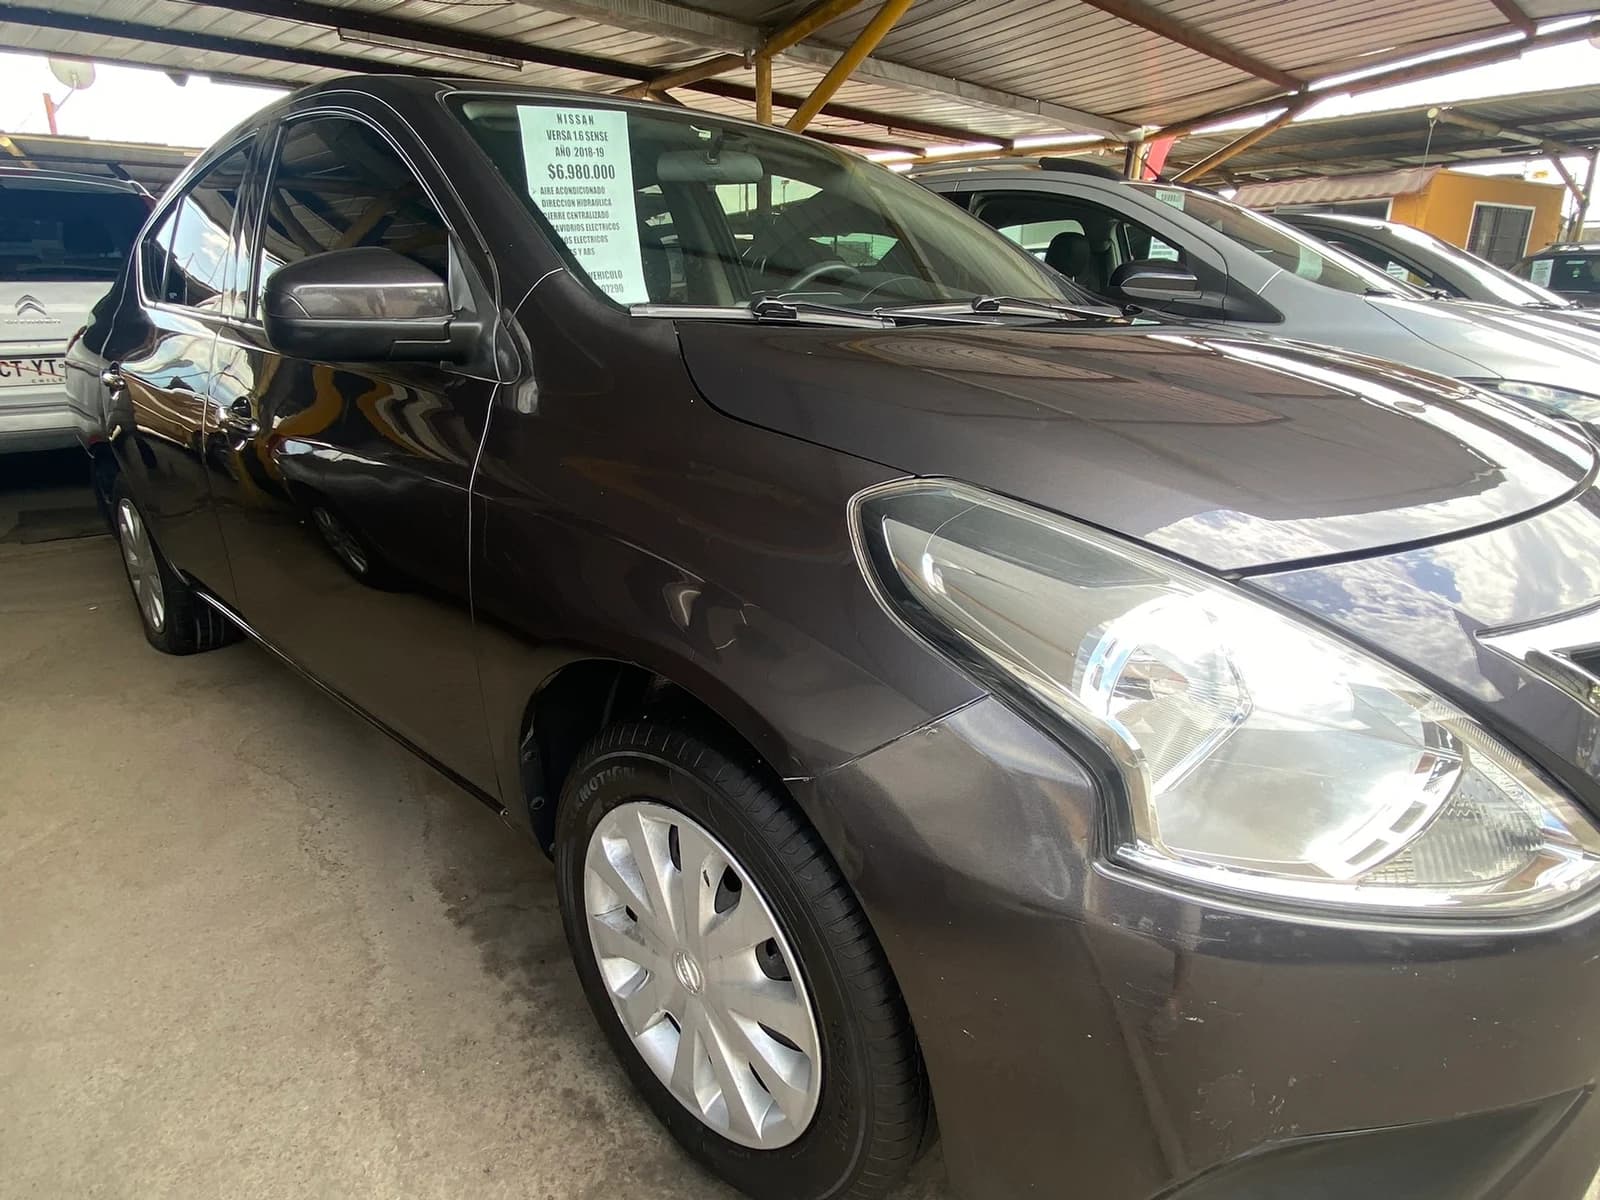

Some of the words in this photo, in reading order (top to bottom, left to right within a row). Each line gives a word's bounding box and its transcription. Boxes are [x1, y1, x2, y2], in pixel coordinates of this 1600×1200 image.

[556, 113, 595, 125] NISSAN
[546, 129, 572, 141] VERSA
[573, 131, 584, 141] 1.6
[586, 131, 609, 142] SENSE
[555, 144, 571, 157] AÑO
[575, 147, 605, 157] 2018-19
[547, 163, 616, 180] $6.980.000
[540, 186, 554, 195] AIRE
[555, 186, 606, 195] ACONDICIONADO
[541, 199, 576, 208] DIRECCION
[567, 210, 610, 220] CENTRALIZADO
[553, 223, 585, 233] AVIDRIOS
[585, 222, 621, 232] ELECTRICOS
[573, 235, 609, 244] ELECTRICOS
[583, 247, 596, 256] ABS
